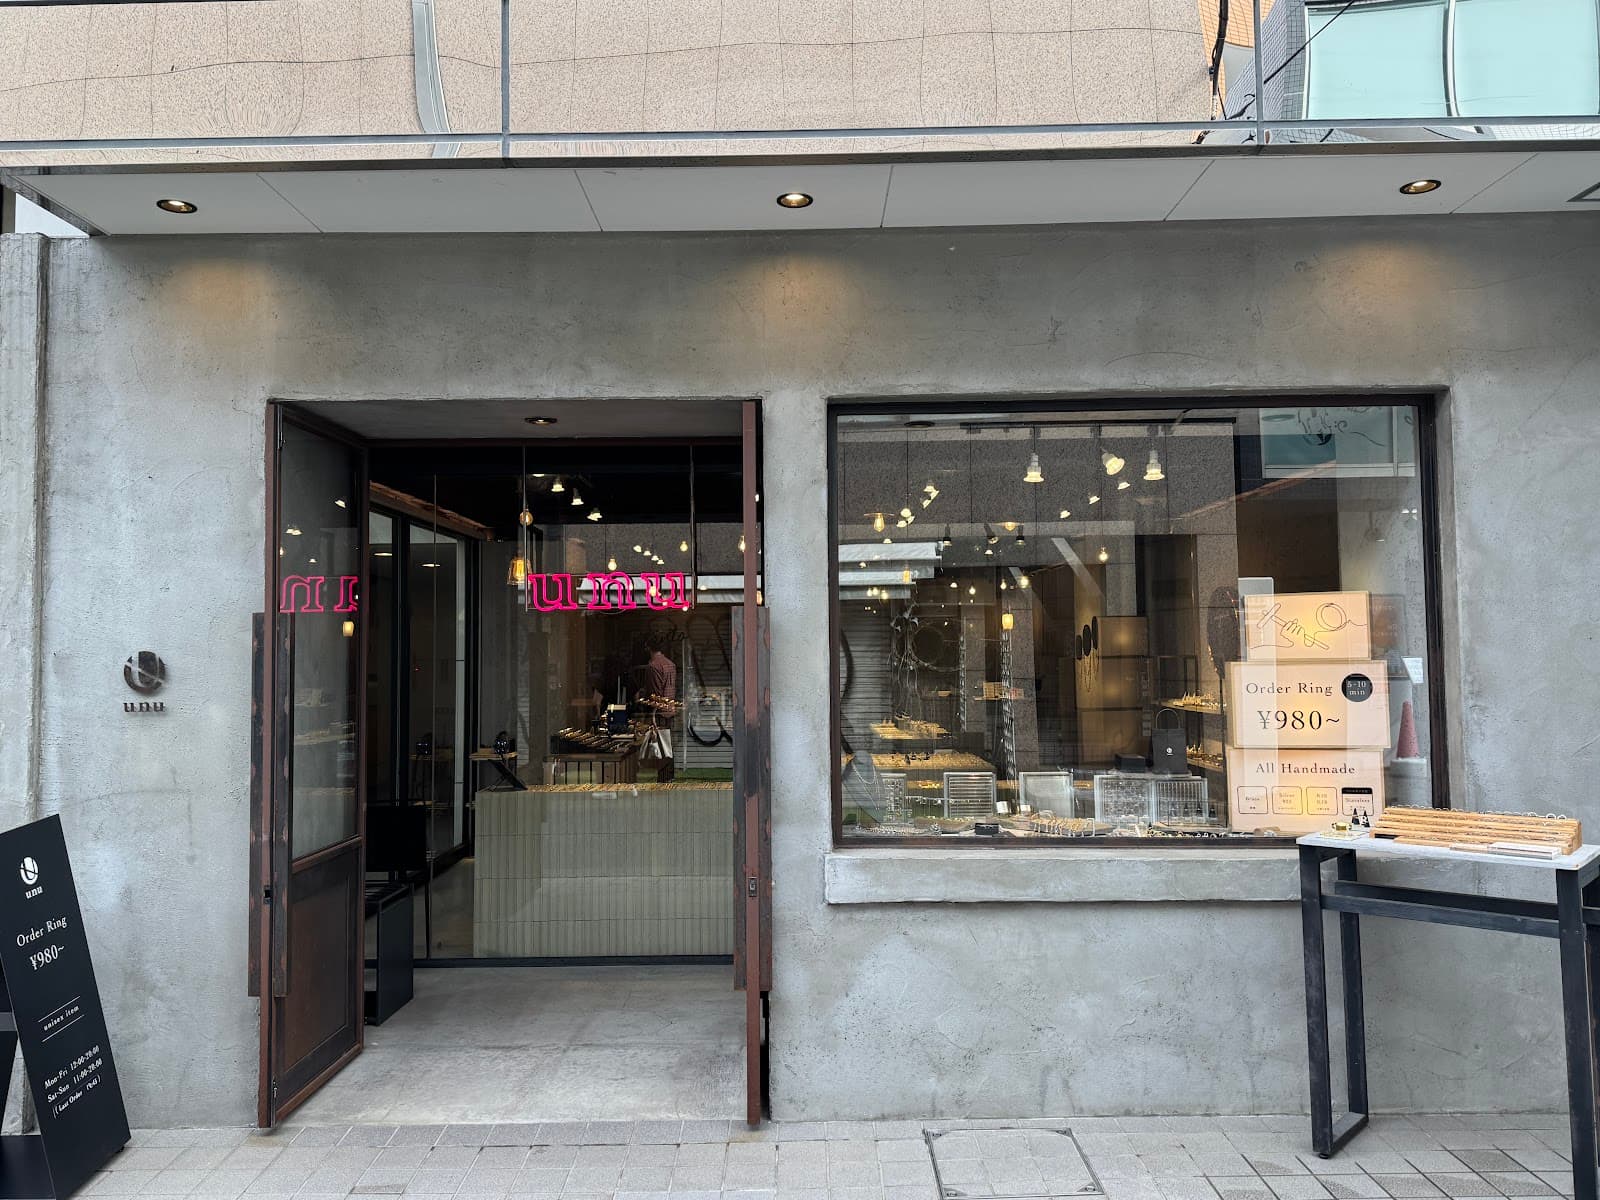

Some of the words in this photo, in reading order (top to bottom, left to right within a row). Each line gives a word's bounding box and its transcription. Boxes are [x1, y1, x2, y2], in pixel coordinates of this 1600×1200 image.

[528, 571, 690, 612] unu
[1246, 682, 1291, 694] Order
[1298, 682, 1333, 696] Ring
[1346, 680, 1367, 688] 5-10
[123, 701, 165, 713] unu
[1256, 762, 1274, 773] All
[1281, 763, 1355, 774] Handmade
[25, 886, 43, 899] unu
[17, 928, 44, 947] Order
[46, 916, 67, 934] Ring
[43, 1015, 64, 1031] unisex
[65, 1004, 79, 1018] item
[47, 1084, 70, 1103] Sat-Sun
